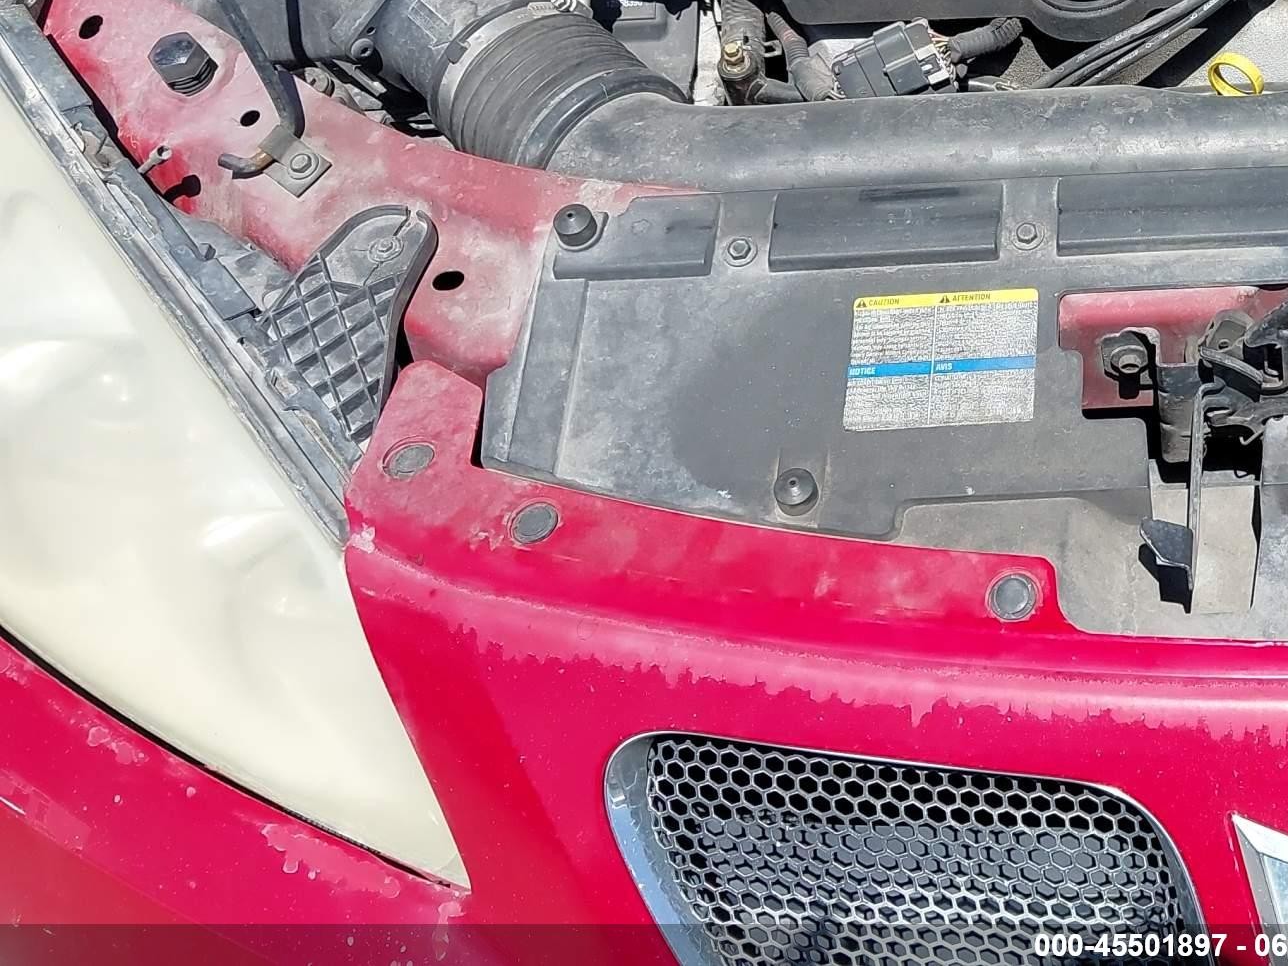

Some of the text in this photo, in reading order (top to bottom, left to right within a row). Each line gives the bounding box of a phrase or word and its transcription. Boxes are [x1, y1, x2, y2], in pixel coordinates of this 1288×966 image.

[952, 293, 991, 302] ATTENTION
[869, 298, 900, 306] CAUTION
[849, 367, 876, 375] NOTICE
[935, 363, 953, 371] AVIS
